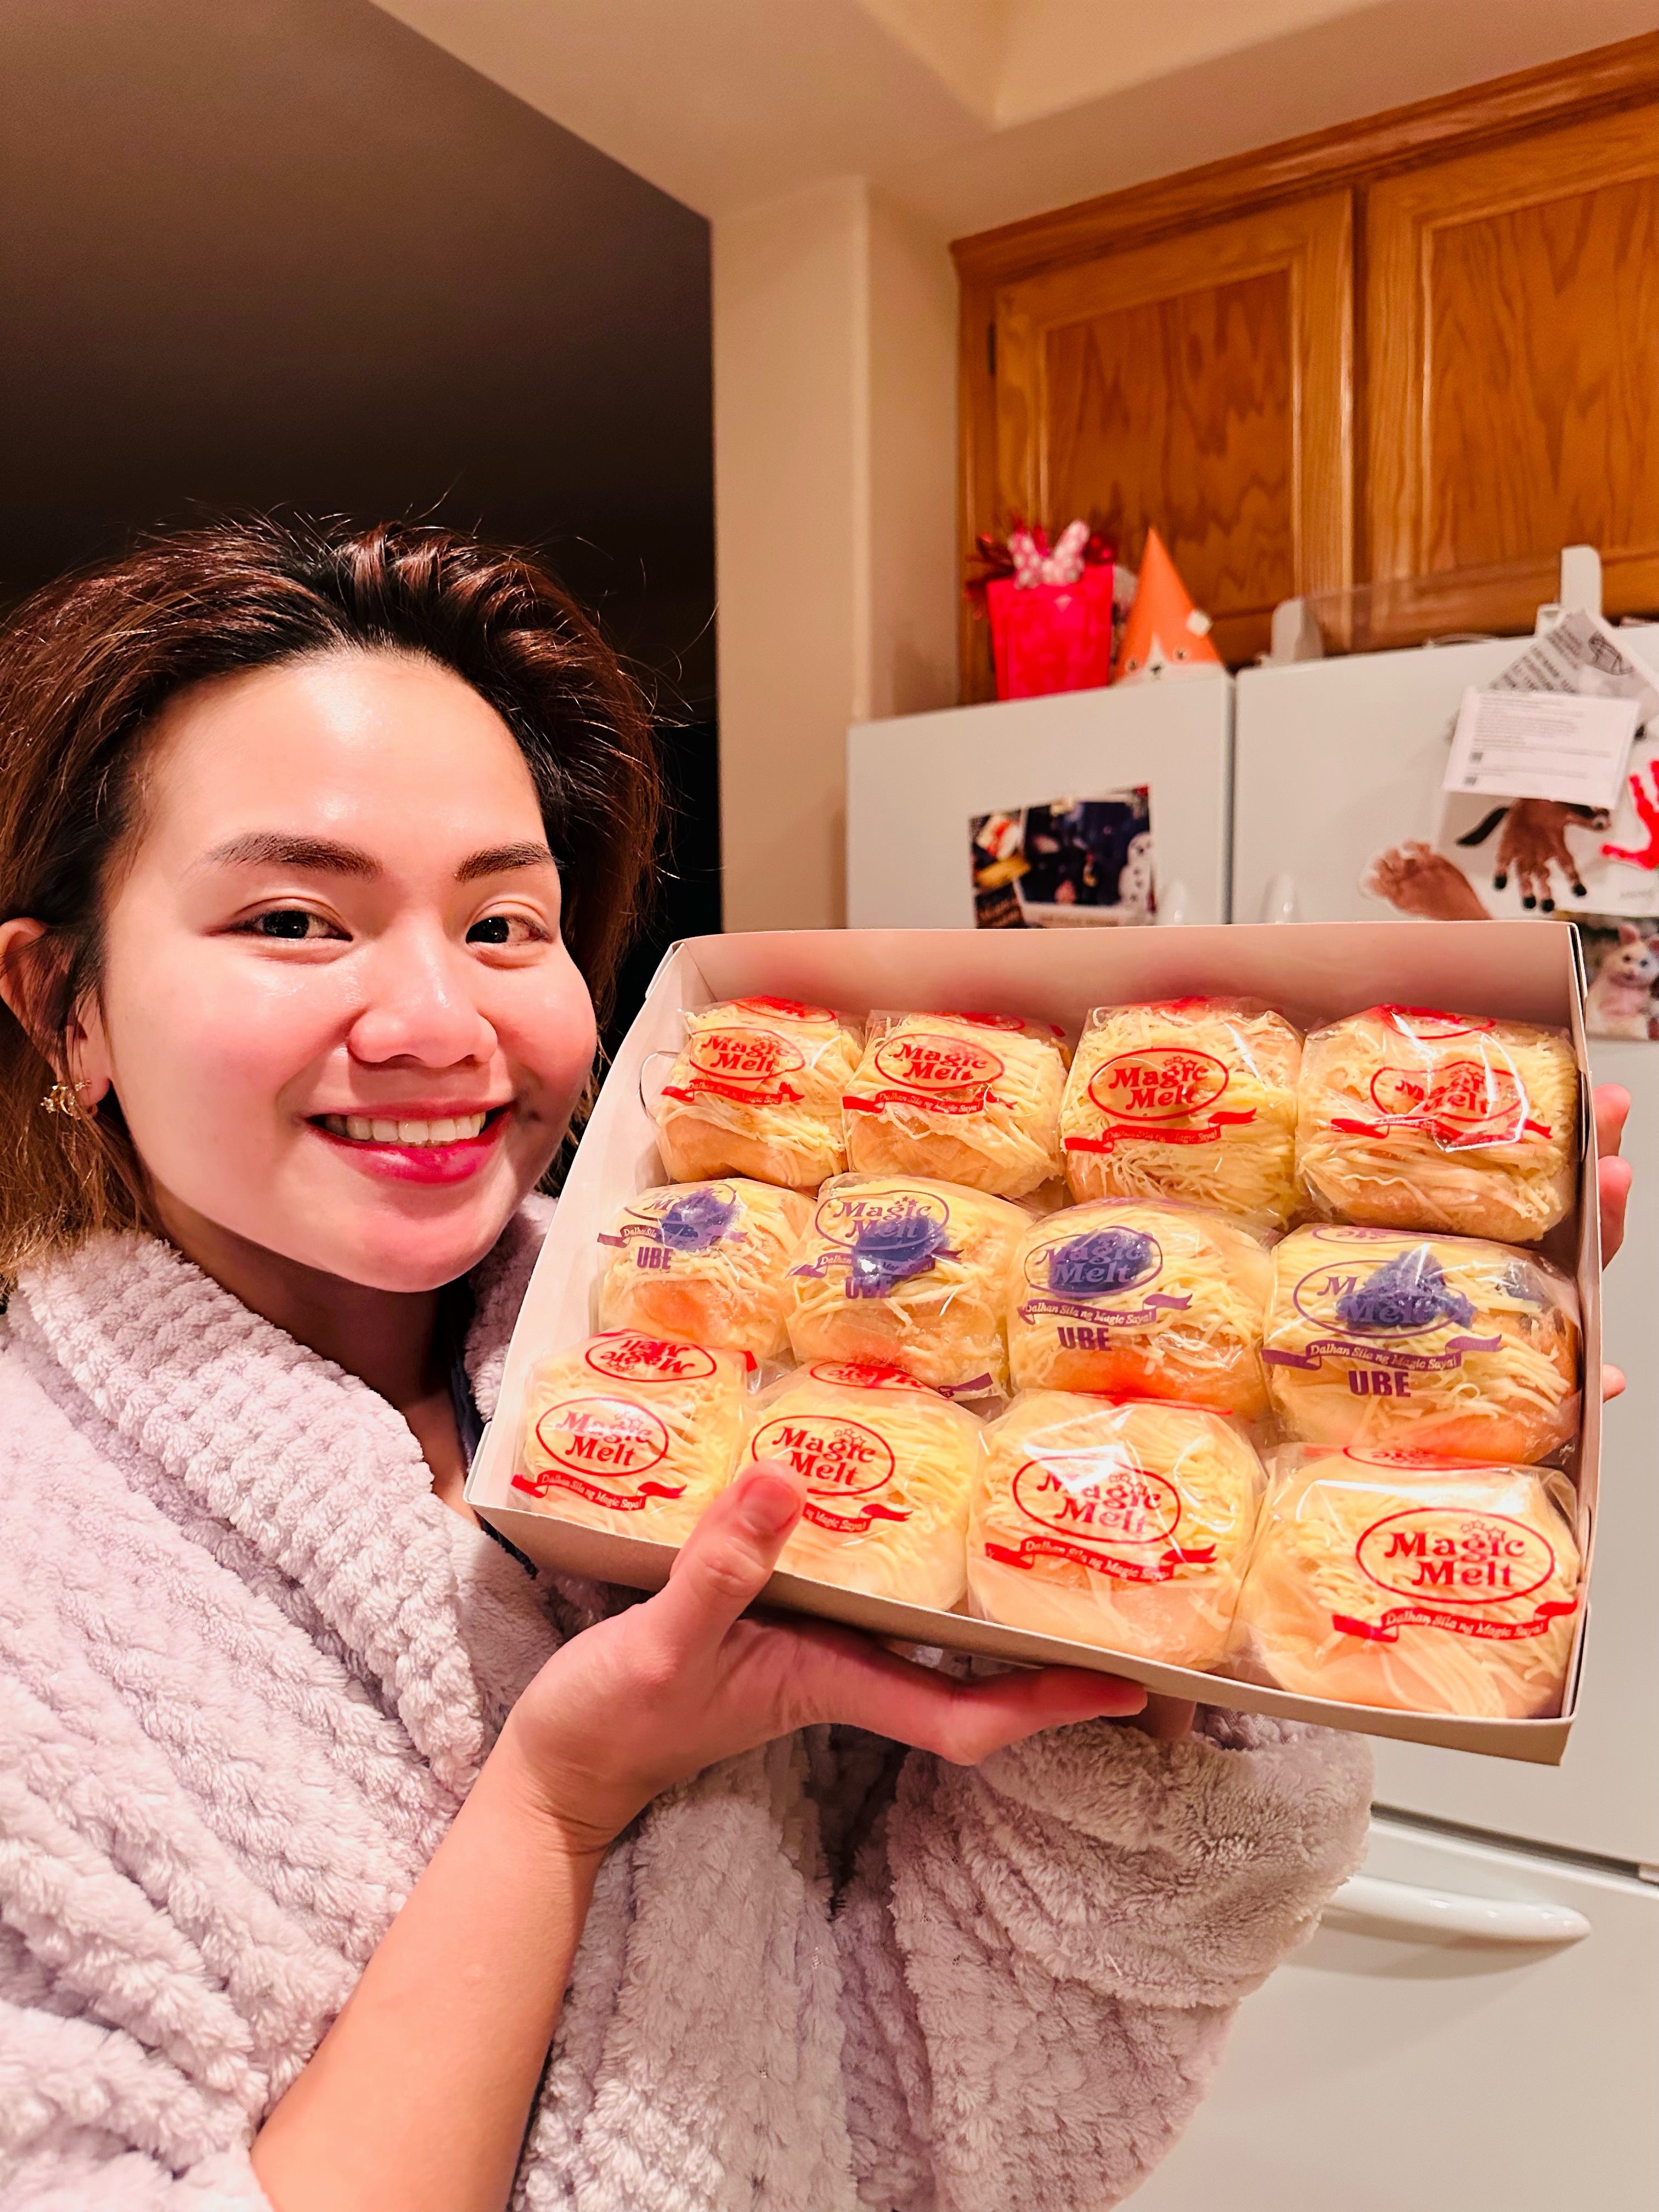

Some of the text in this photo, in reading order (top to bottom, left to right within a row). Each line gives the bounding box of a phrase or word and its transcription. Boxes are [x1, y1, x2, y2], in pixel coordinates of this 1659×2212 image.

[701, 1035, 791, 1058] Magic
[893, 1043, 988, 1069] Magic
[710, 1053, 775, 1072] Melt
[902, 1062, 973, 1081] Melt
[1108, 1064, 1209, 1089] Magic
[1125, 1087, 1194, 1110] Melt
[833, 1200, 932, 1221] Magic
[845, 1220, 919, 1239] Melt
[636, 1246, 674, 1270] UBE
[1035, 1245, 1143, 1266] Magic
[1049, 1261, 1132, 1284] Melt
[845, 1275, 891, 1300] UBE
[1059, 1305, 1080, 1317] Sila
[1080, 1310, 1094, 1321] ng
[1125, 1311, 1152, 1325] Saya!
[1057, 1327, 1113, 1351] UBE
[1310, 1344, 1350, 1356] Dalhan
[1351, 1347, 1374, 1359] Sila
[1375, 1354, 1390, 1365] ng
[1427, 1356, 1457, 1370] Saya!
[1348, 1370, 1412, 1398] UBE
[565, 1435, 637, 1466] Melt
[771, 1426, 876, 1463] Magic
[790, 1449, 859, 1486] Melt
[1054, 1497, 1149, 1535] Melt
[1384, 1531, 1526, 1563] Magic
[1411, 1561, 1514, 1587] Melt
[1385, 1610, 1431, 1626] Dalhan
[1432, 1614, 1458, 1630] Sila
[1475, 1622, 1512, 1639] Magic
